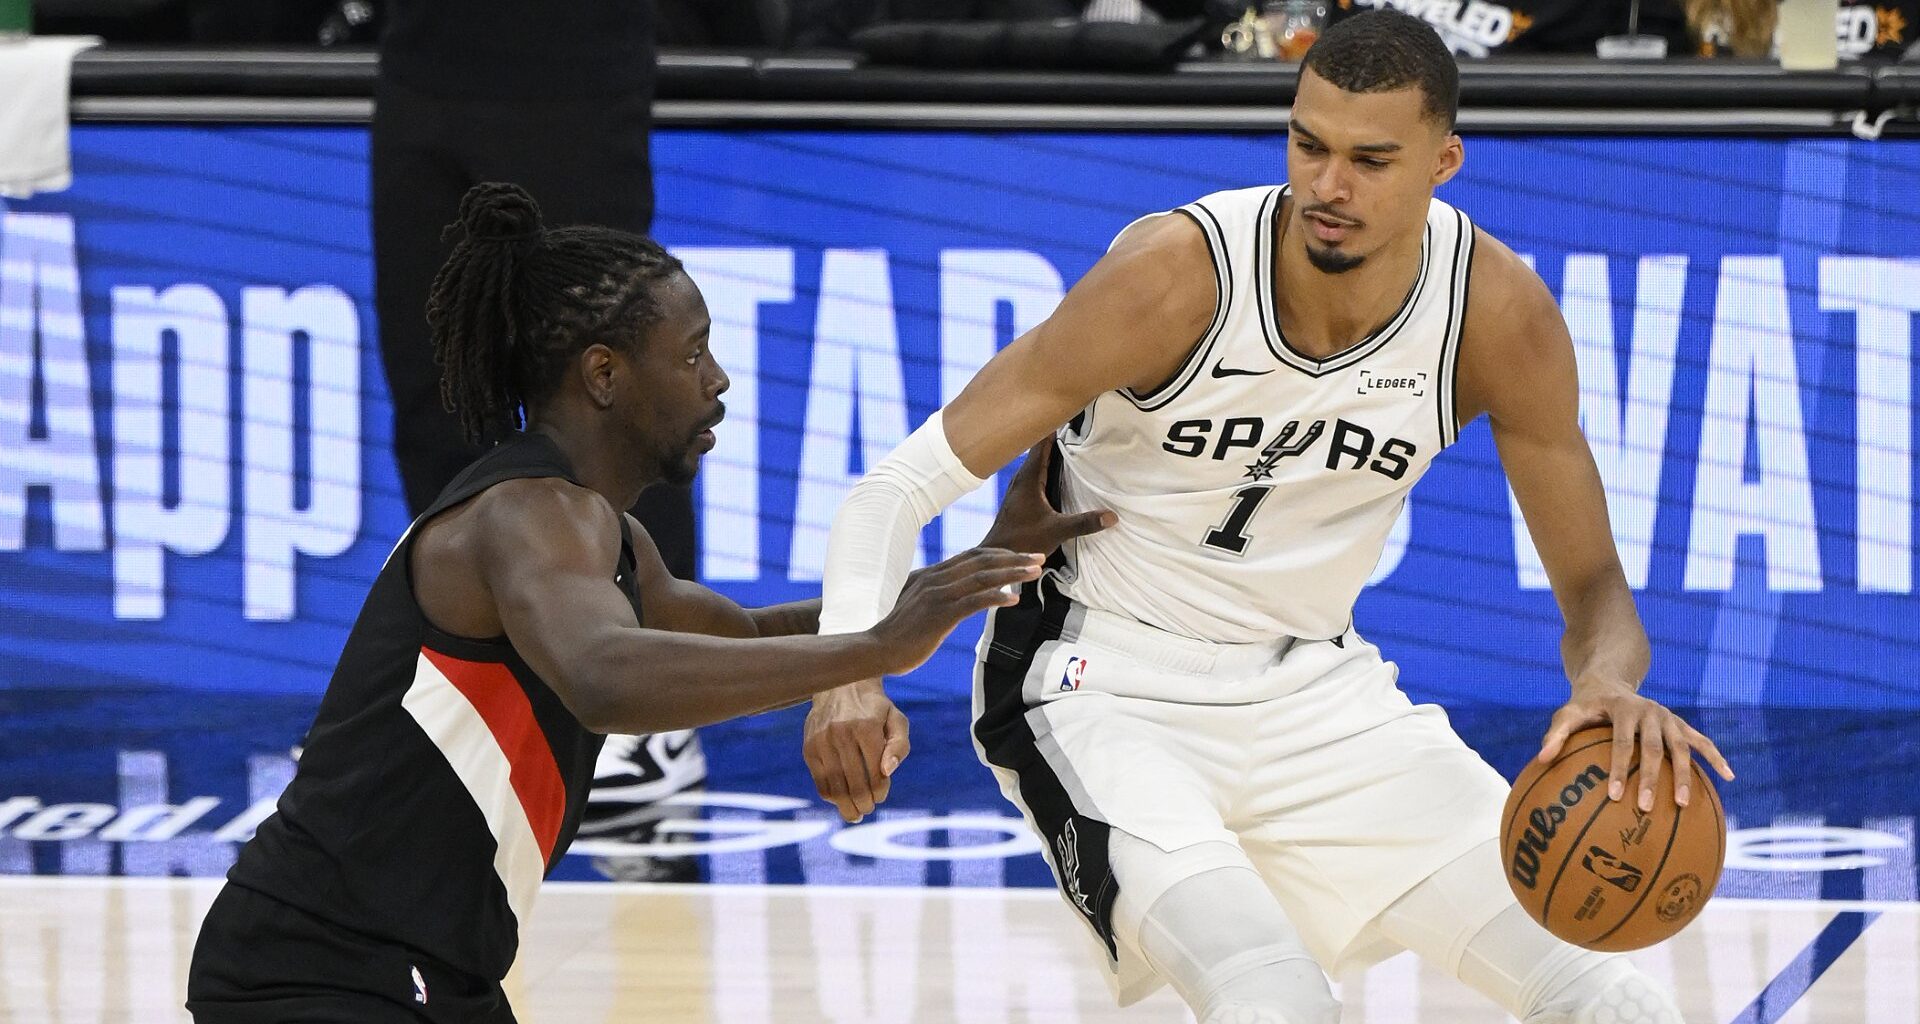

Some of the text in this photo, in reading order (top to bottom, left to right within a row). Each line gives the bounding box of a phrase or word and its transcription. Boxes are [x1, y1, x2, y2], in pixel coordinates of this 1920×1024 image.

[0, 212, 362, 620] App
[1366, 377, 1417, 390] LEDGER
[1162, 416, 1417, 482] SPURS
[1200, 483, 1276, 557] 1
[1513, 763, 1610, 890] Wilson
